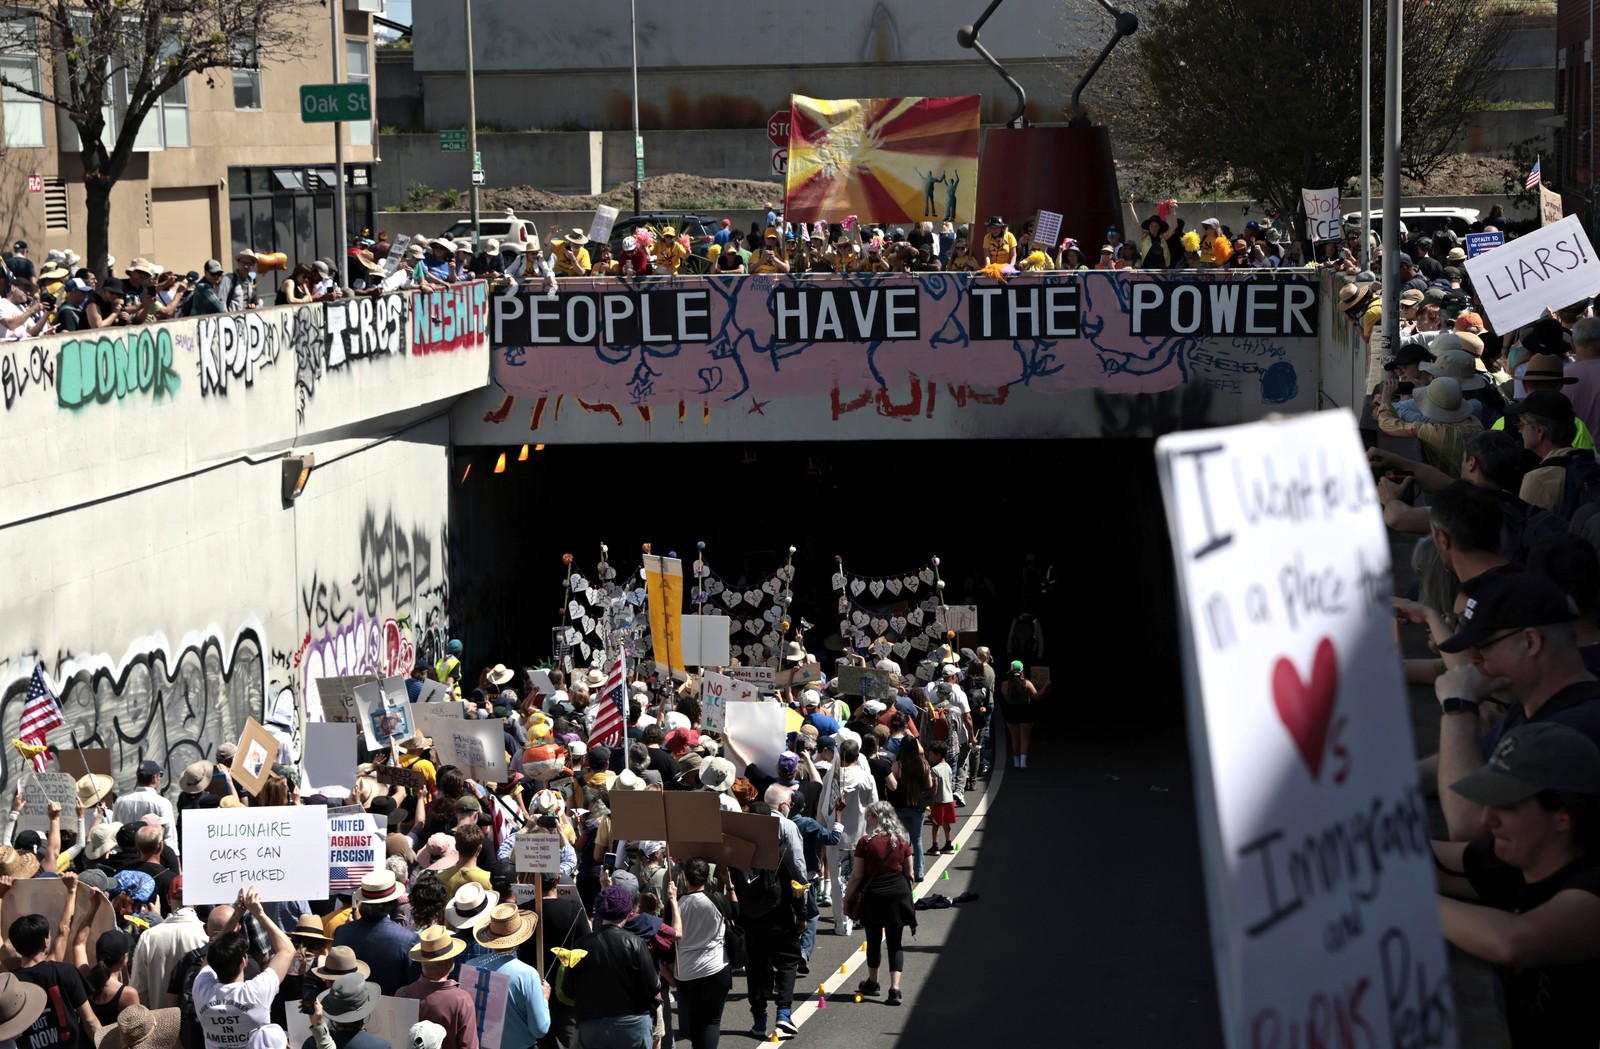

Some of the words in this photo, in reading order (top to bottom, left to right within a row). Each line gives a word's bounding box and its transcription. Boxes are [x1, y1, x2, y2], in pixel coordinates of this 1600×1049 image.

[303, 94, 339, 113] Oak
[347, 92, 368, 112] St
[1303, 192, 1340, 219] Stop
[1307, 217, 1341, 239] ICE
[1485, 232, 1588, 301] LIARS!
[493, 290, 709, 344] PEOPLE
[776, 288, 917, 340] HAVE
[971, 286, 1077, 337] THE
[1132, 283, 1315, 335] POWER
[1178, 443, 1236, 562] I
[707, 680, 723, 696] NO
[706, 694, 726, 709] ICE
[377, 766, 412, 778] WORLD
[391, 776, 420, 788] PEACE
[207, 821, 291, 838] BILLIONAIRE
[330, 819, 365, 832] UNITED
[330, 835, 372, 847] AGAINST
[209, 847, 247, 861] CUCKS
[256, 845, 281, 859] CAN
[330, 849, 375, 863] FASCISM
[212, 869, 237, 884] GET
[239, 869, 285, 882] FUCKED
[209, 999, 222, 1007] YOU
[234, 1001, 250, 1013] BEEN
[31, 1015, 48, 1031] OUT
[211, 1015, 240, 1025] LOST
[222, 1025, 235, 1034] IN
[29, 1027, 59, 1049] NOW
[206, 1032, 250, 1043] AMERICA
